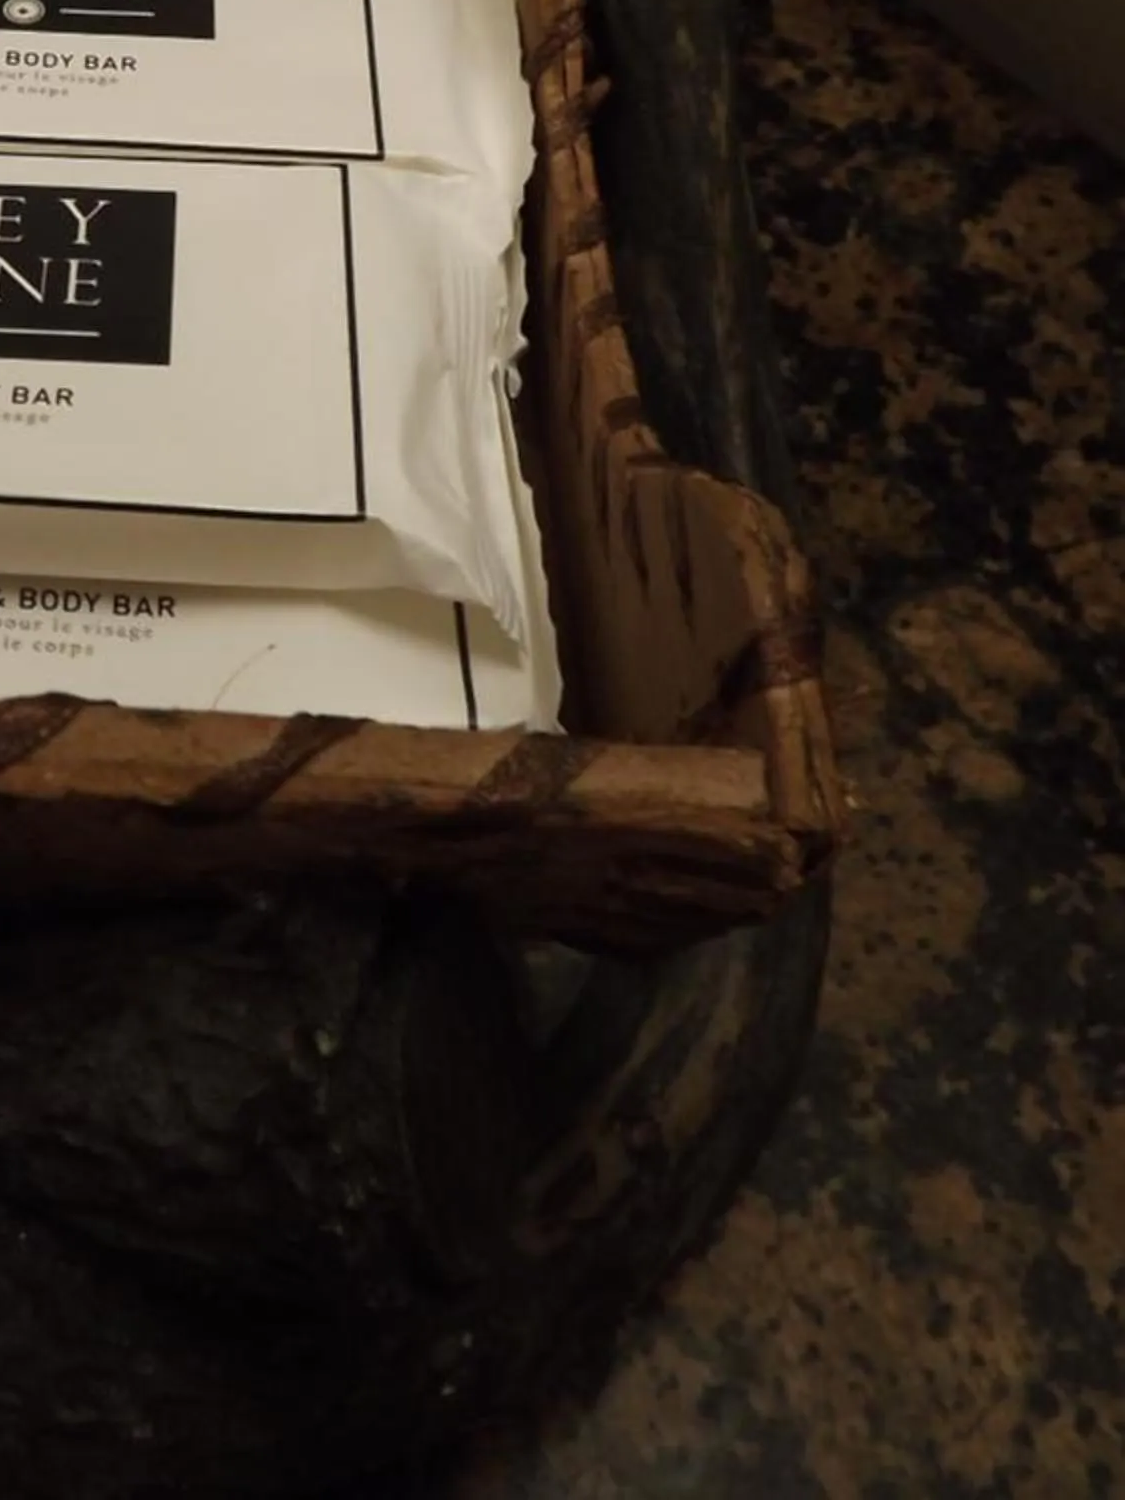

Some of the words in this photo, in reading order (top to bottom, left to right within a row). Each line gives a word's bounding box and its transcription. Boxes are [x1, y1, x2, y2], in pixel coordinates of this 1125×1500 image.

[5, 50, 74, 69] BODY
[84, 54, 138, 71] BAR
[11, 386, 75, 407] BAR
[18, 586, 103, 613] BODY
[112, 594, 177, 618] BAR
[51, 616, 72, 634] le
[81, 621, 154, 642] visage
[2, 634, 22, 652] le
[32, 638, 96, 659] corps
